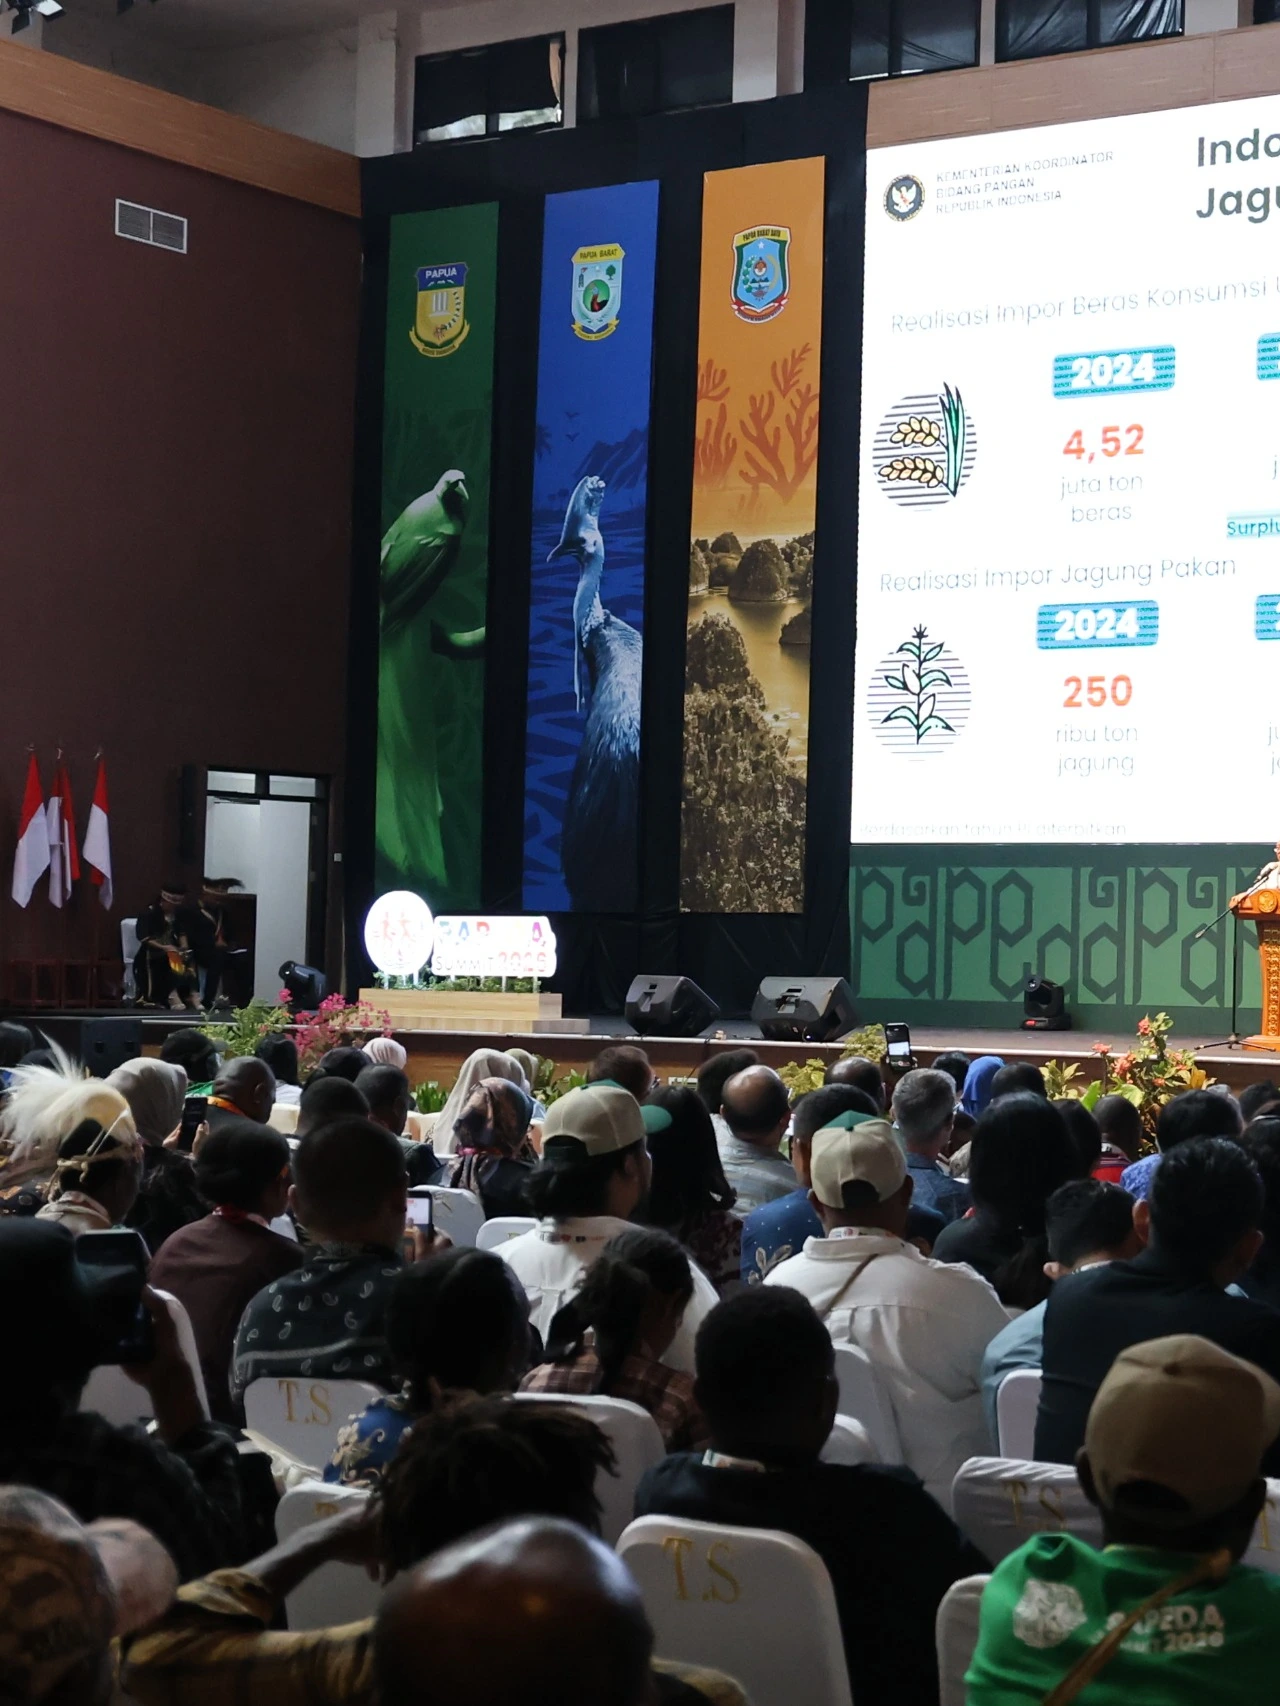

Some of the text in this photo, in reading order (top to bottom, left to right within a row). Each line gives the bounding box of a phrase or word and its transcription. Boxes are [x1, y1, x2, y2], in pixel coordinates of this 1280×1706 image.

[936, 151, 1114, 182] KEMENTERIAN KOORDINATOR
[936, 177, 1035, 199] BIDANG PANGAN
[936, 190, 1063, 214] REPUBLIK INDONESIA
[425, 267, 458, 279] PAPUA
[892, 309, 989, 333] Realisasi
[997, 301, 1065, 326] Impor
[1073, 293, 1139, 316] Beras
[1147, 279, 1268, 308] Konsumsi
[1069, 352, 1157, 389] 2024
[1062, 423, 1144, 463] 4,52
[1060, 473, 1143, 501] juta ton
[1071, 502, 1132, 523] beras
[880, 555, 1236, 592] Realisasi Impor Jagung Pakan
[1054, 608, 1140, 642] 2024
[1063, 674, 1133, 708] 250
[1056, 723, 1138, 743] ribu ton
[1057, 752, 1135, 777] jagung
[661, 1534, 742, 1605] T.S
